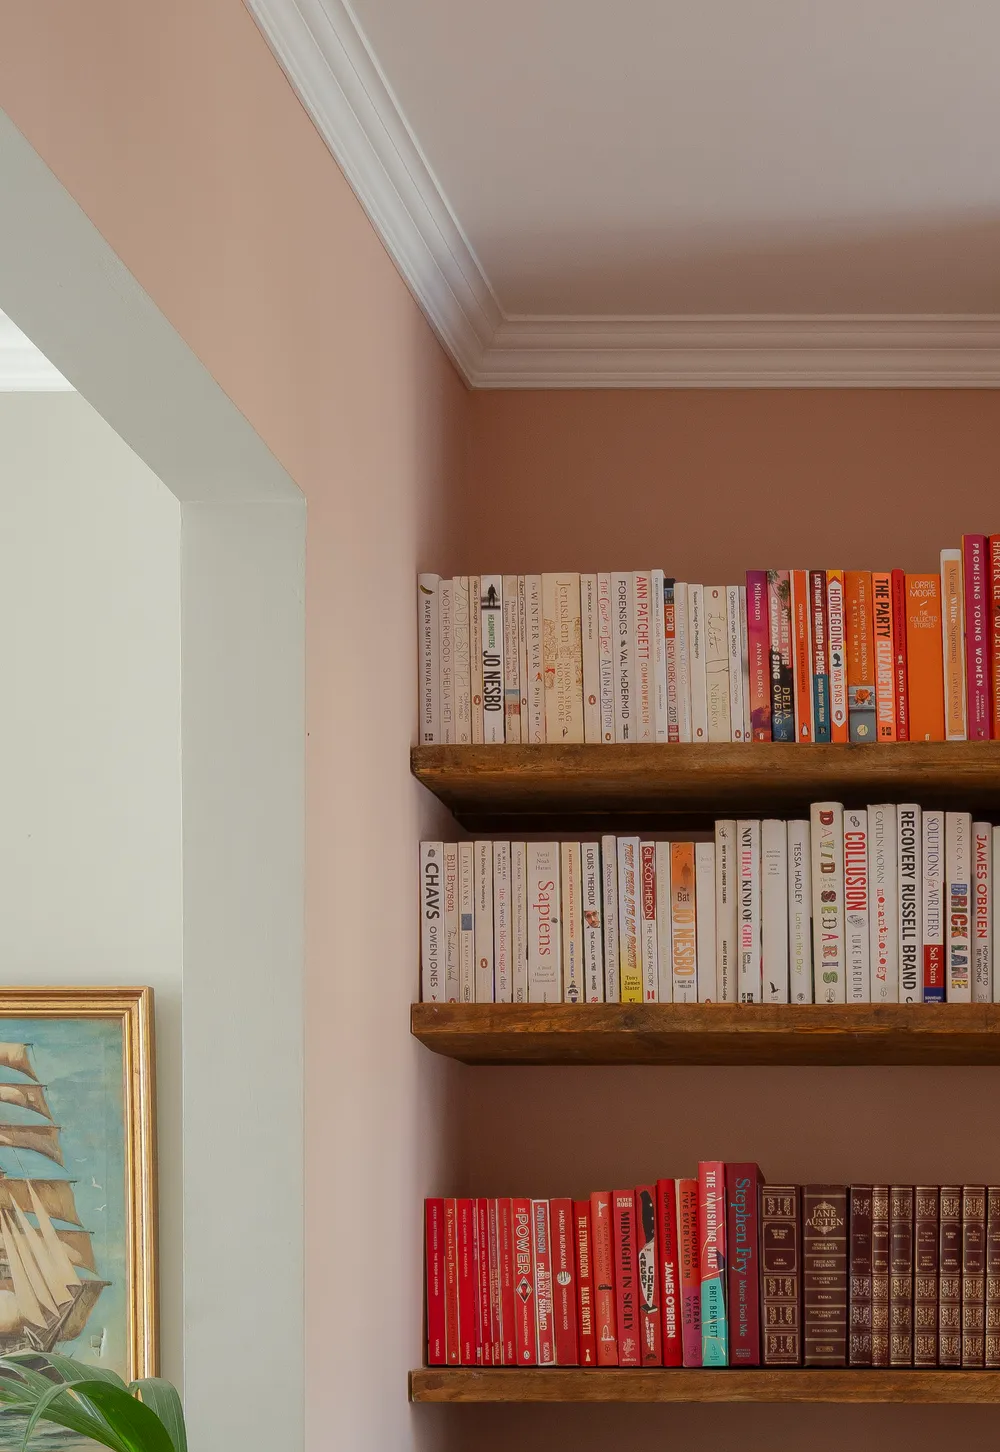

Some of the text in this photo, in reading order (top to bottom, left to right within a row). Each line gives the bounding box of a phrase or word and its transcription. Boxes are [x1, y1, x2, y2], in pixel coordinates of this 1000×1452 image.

[666, 607, 674, 631] TOP10
[754, 583, 762, 620] Milkman
[830, 589, 842, 650] HOMEGOING
[483, 651, 500, 666] JO
[618, 581, 629, 718] FORENSICS VAL McDERMID
[636, 576, 649, 723] ANN PATCHETT COMMONWEALTH
[875, 579, 893, 723] THE PARTY ELIZABETH DAY
[975, 648, 983, 686] WOMEN
[484, 671, 501, 711] NESBO
[587, 849, 595, 905] LOUIS THEROUX
[742, 828, 752, 948] NOT THAT KIND OF GIRL
[794, 842, 802, 905] TESSA HADLEY
[819, 811, 839, 984] DAVID SEDARIS
[876, 811, 888, 981] CAITLIN MORAN moranthology
[901, 811, 916, 989] RECOVERY RUSSELL BRAND
[976, 834, 987, 938] JAMES O'BRIEN
[425, 863, 439, 987] CHAVS OWEN JONES
[533, 880, 554, 956] Sapiens
[673, 905, 695, 975] JO NESBO
[845, 832, 866, 998] COLLUSION LUKE HARDING
[951, 883, 968, 989] BRICK LANE
[706, 1171, 715, 1188] THE
[516, 1214, 530, 1274] POWER
[707, 1192, 717, 1242] VANISHING
[731, 1178, 751, 1275] Stephen Fry
[805, 1218, 843, 1226] AUSTEN
[579, 1230, 588, 1277] ETYMOLOGICON
[620, 1211, 633, 1331] MIDNIGHT IN SICILY
[707, 1247, 717, 1269] HALF
[537, 1263, 546, 1330] PUBLICLY SHAMED
[581, 1287, 589, 1305] MARK
[582, 1307, 590, 1335] FORSYTH
[665, 1262, 675, 1338] JAMES O'BRIEN
[710, 1305, 718, 1338] BENNETT
